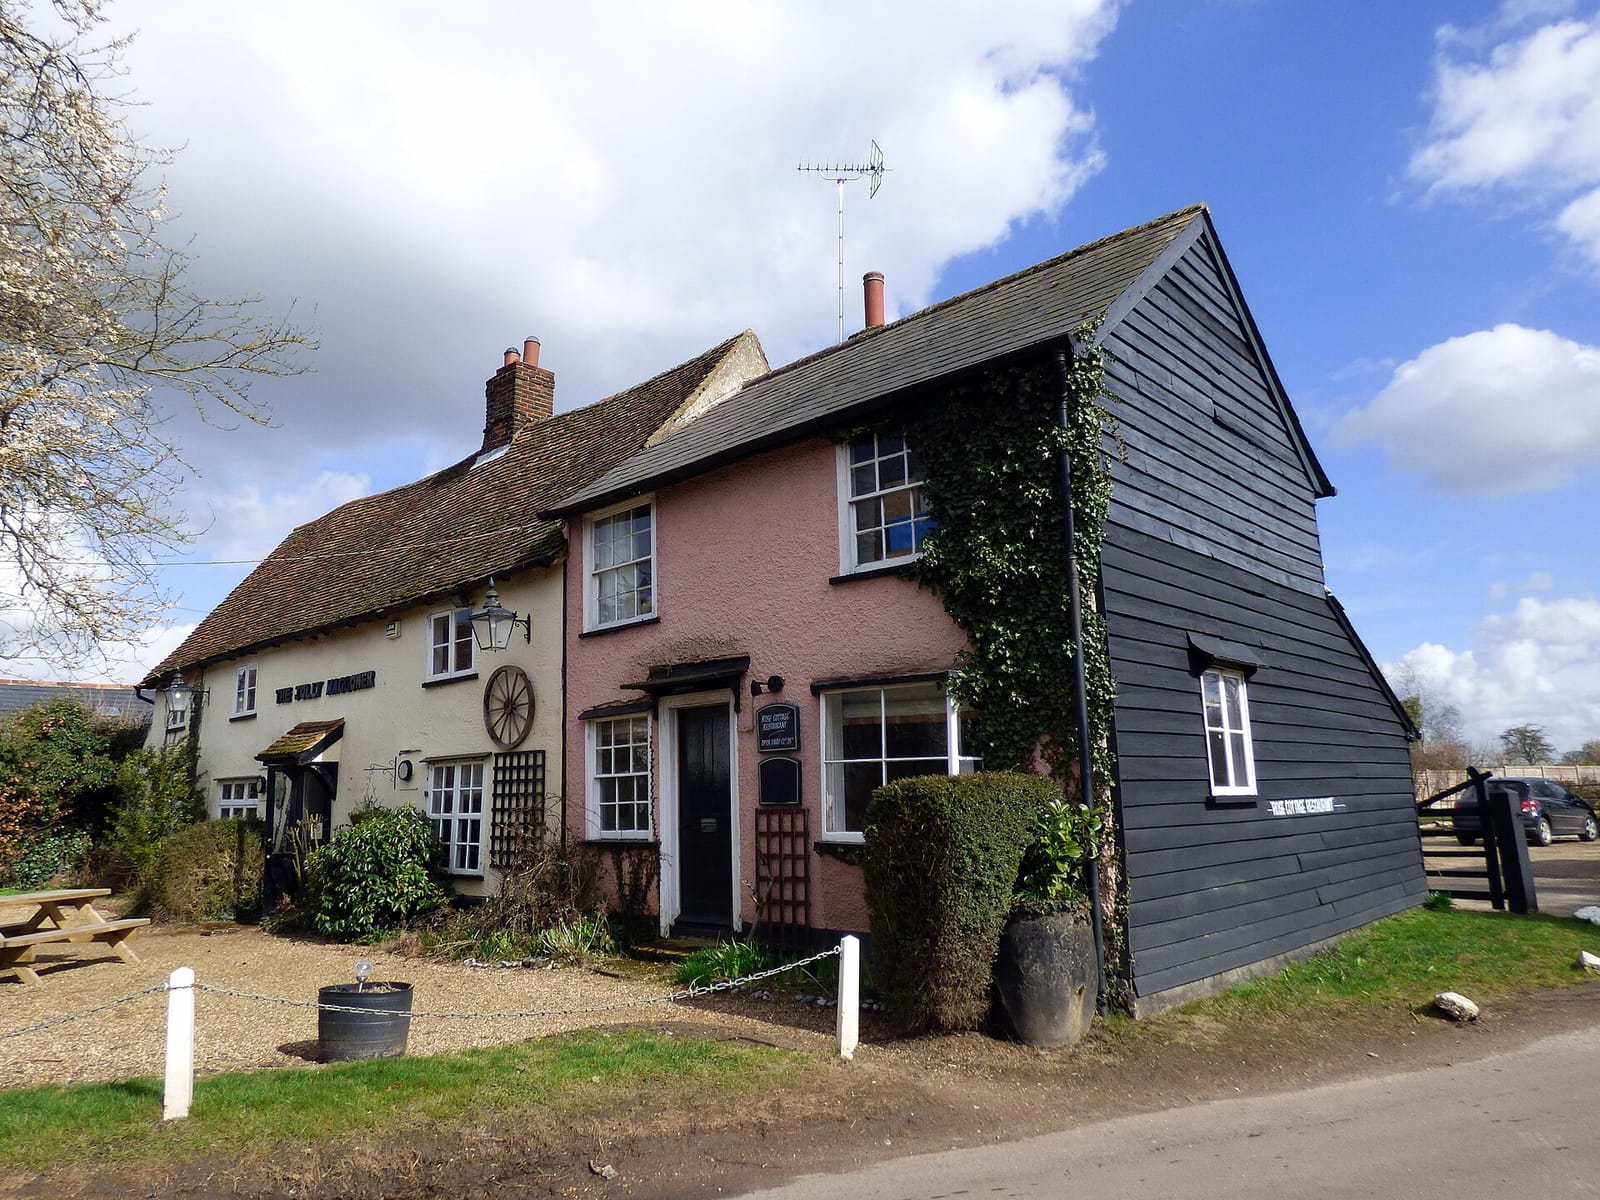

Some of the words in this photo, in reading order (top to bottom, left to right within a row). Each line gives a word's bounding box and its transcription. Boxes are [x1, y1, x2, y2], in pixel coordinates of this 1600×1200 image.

[276, 687, 293, 704] THE
[294, 681, 325, 701] JOLLY
[326, 670, 376, 696] WAGGONER
[1270, 800, 1286, 816] ROSE
[1285, 799, 1306, 815] COTTAGE
[1305, 797, 1334, 813] RESTAURANT
